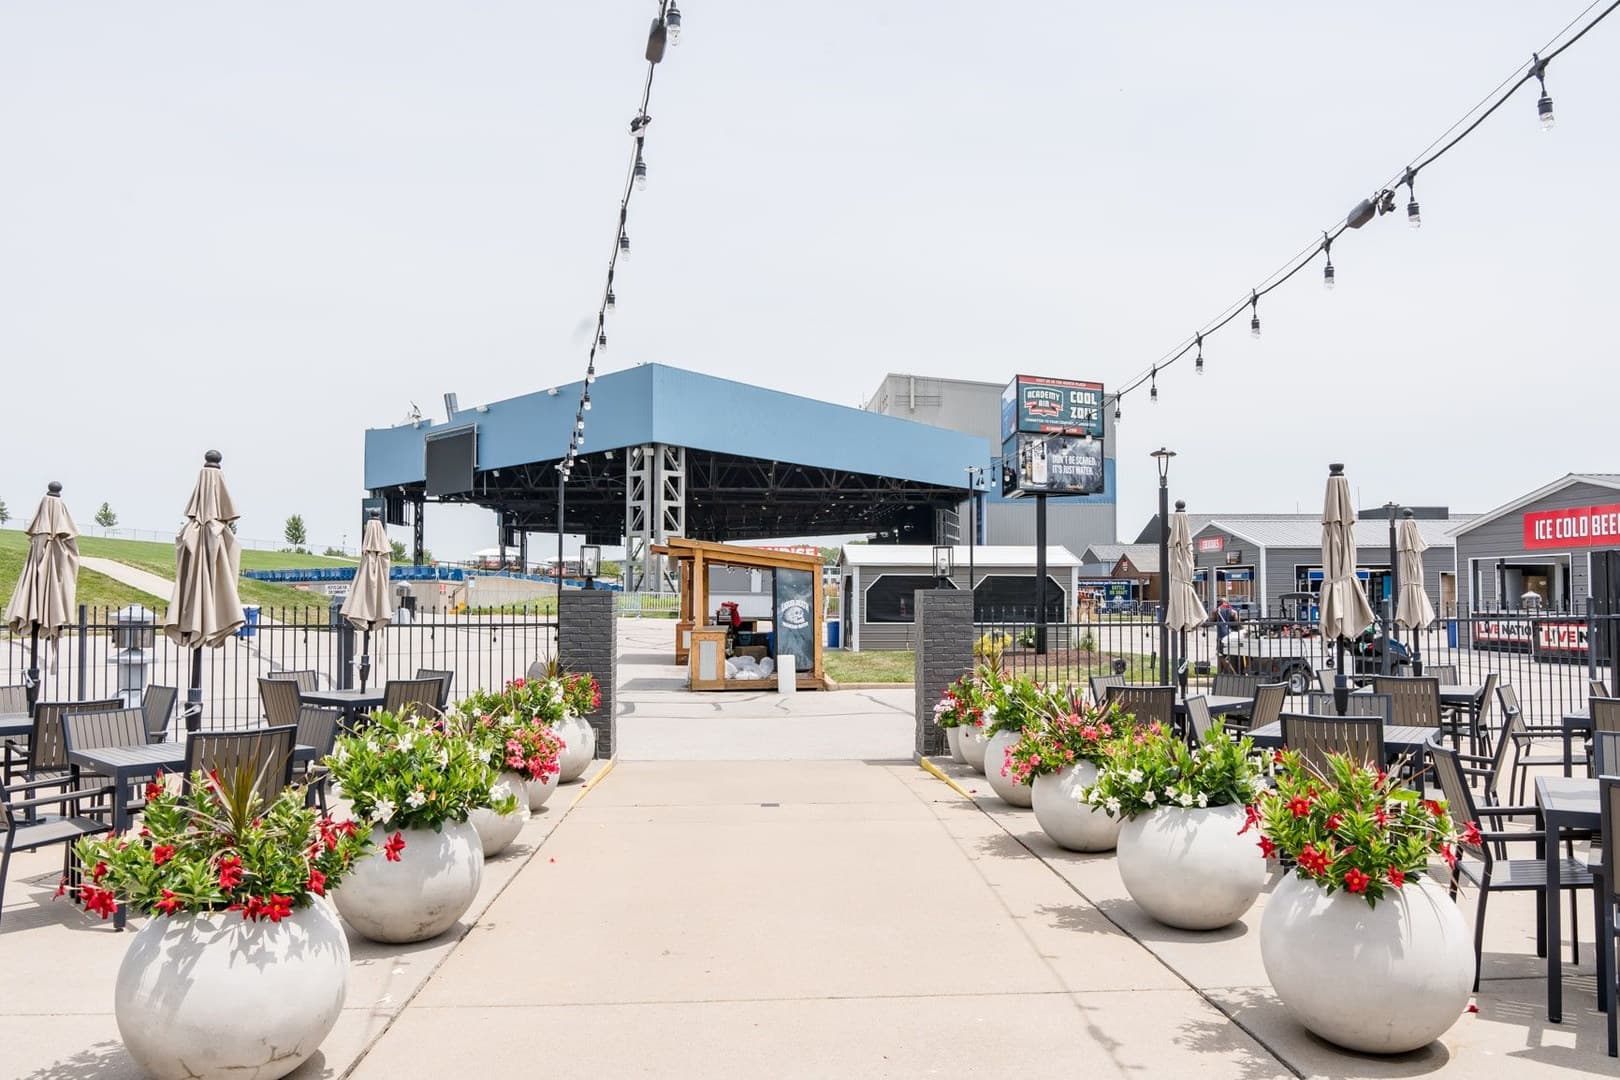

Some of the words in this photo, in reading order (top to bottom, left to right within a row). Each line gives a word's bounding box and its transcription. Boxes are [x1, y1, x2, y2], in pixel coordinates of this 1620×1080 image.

[1027, 390, 1060, 401] ACADEMY
[1070, 391, 1097, 405] COOL
[1052, 455, 1068, 464] DON'T
[1068, 456, 1075, 465] BE
[1052, 465, 1062, 474] IT'S
[1063, 465, 1075, 475] JUST
[1535, 519, 1553, 540] ICE
[1556, 516, 1588, 539] COLD
[1502, 624, 1532, 636] NATIO
